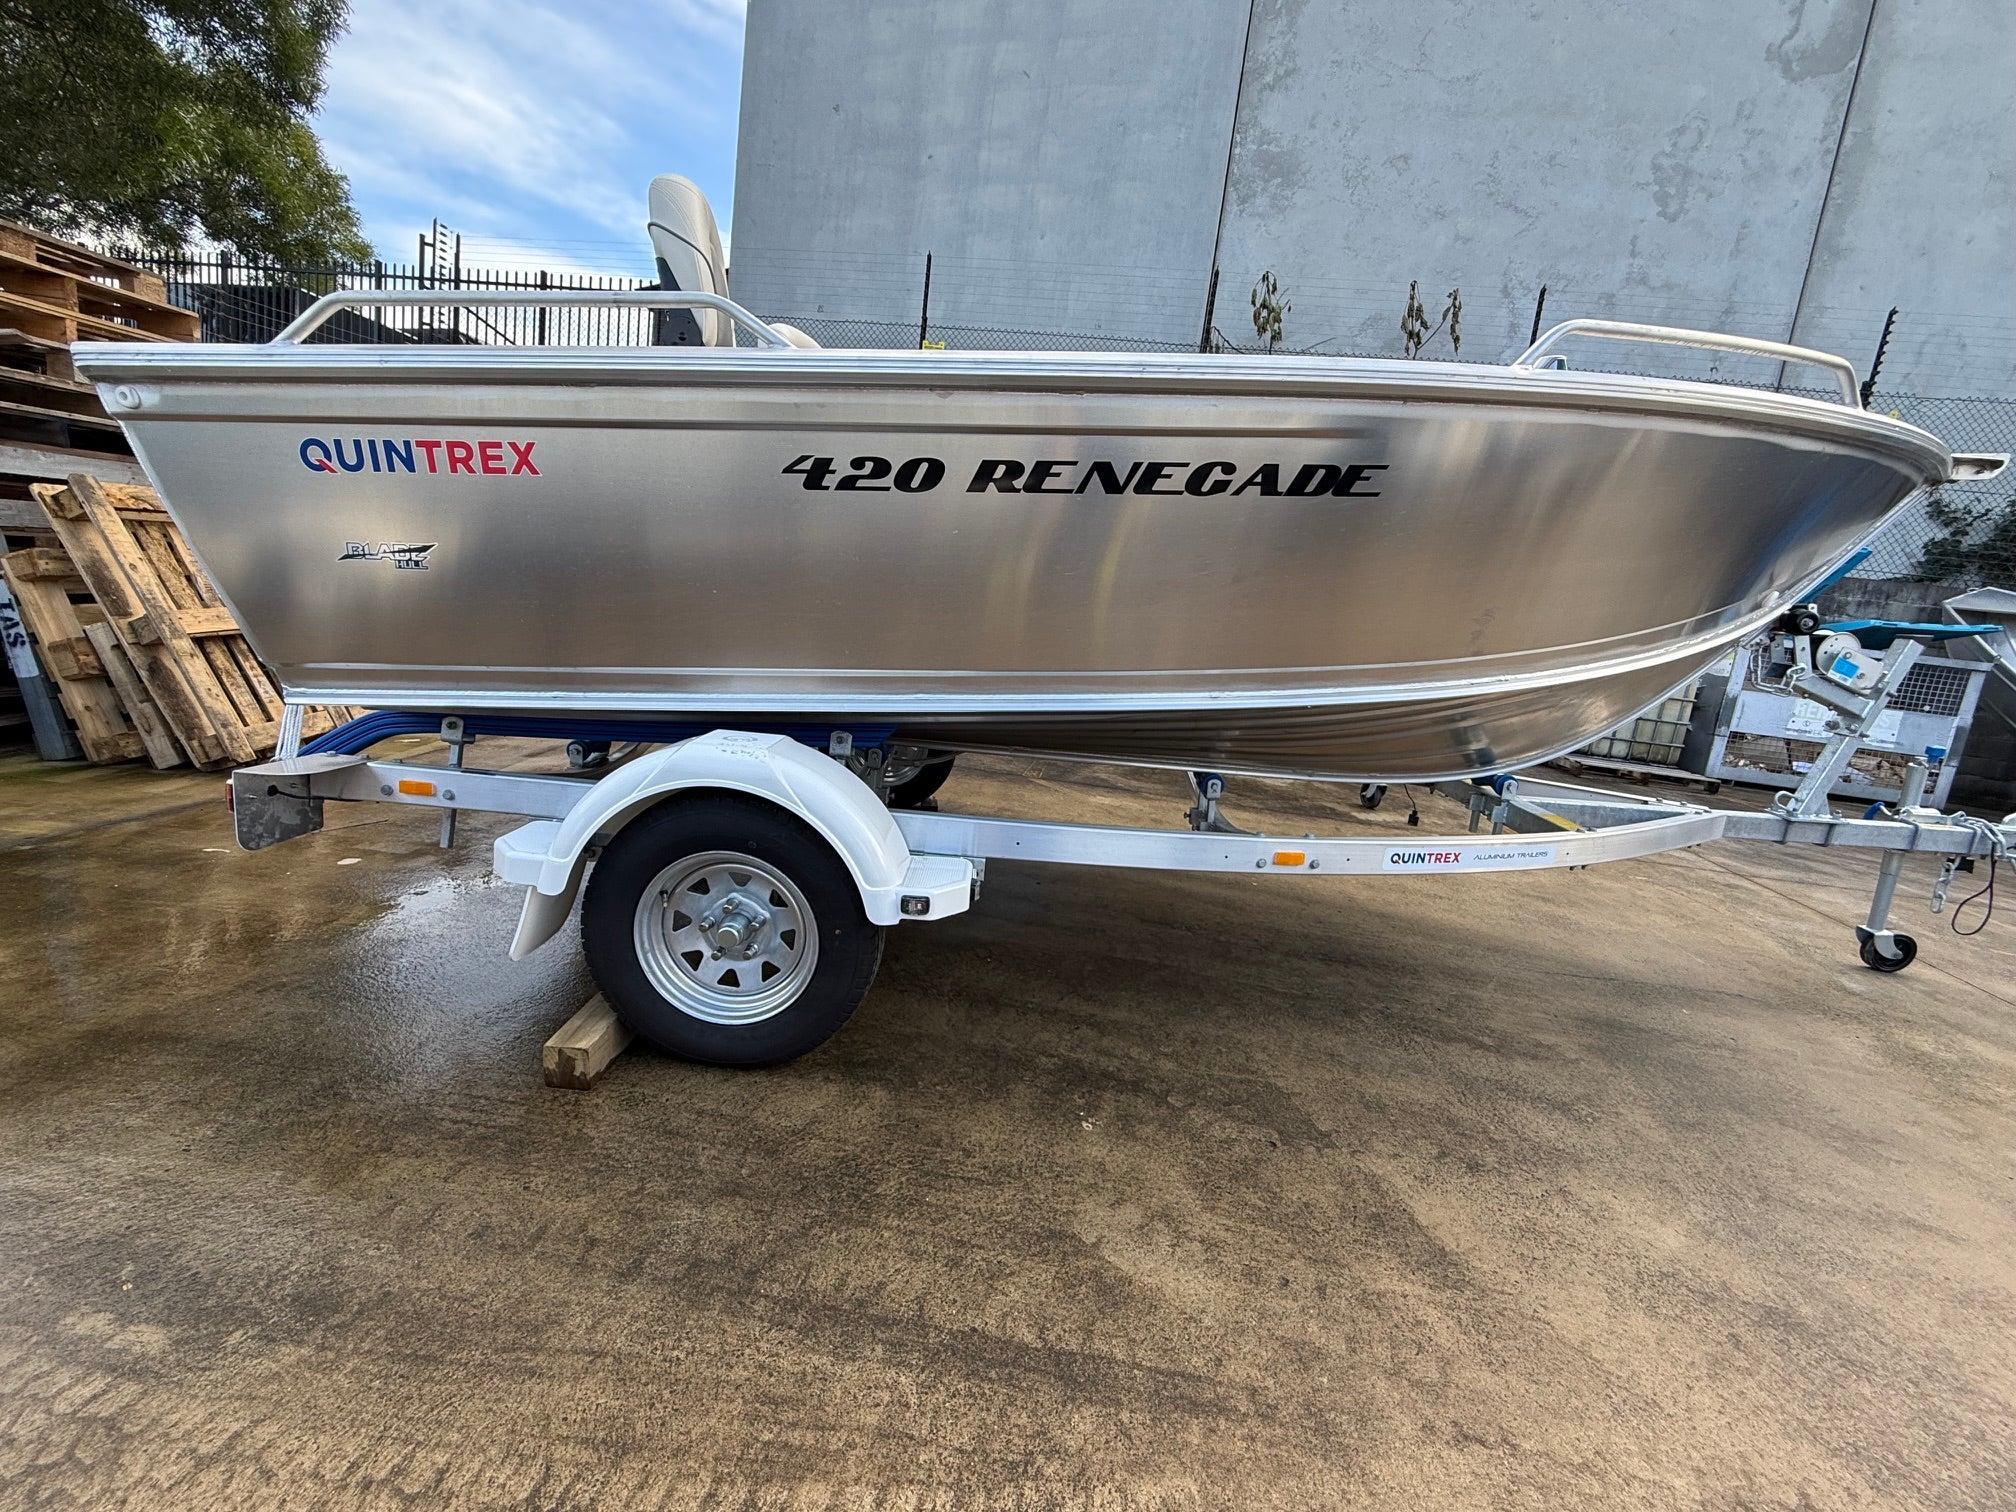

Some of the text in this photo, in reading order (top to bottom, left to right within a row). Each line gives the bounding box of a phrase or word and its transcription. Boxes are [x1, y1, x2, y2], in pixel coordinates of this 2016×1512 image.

[299, 437, 542, 476] QUINTREX
[780, 454, 1390, 498] 420 RENEGADE
[342, 541, 436, 561] BLADE
[395, 560, 429, 570] HULL
[1390, 850, 1548, 865] QUINTREX ALUMINIUM TRAILERS
